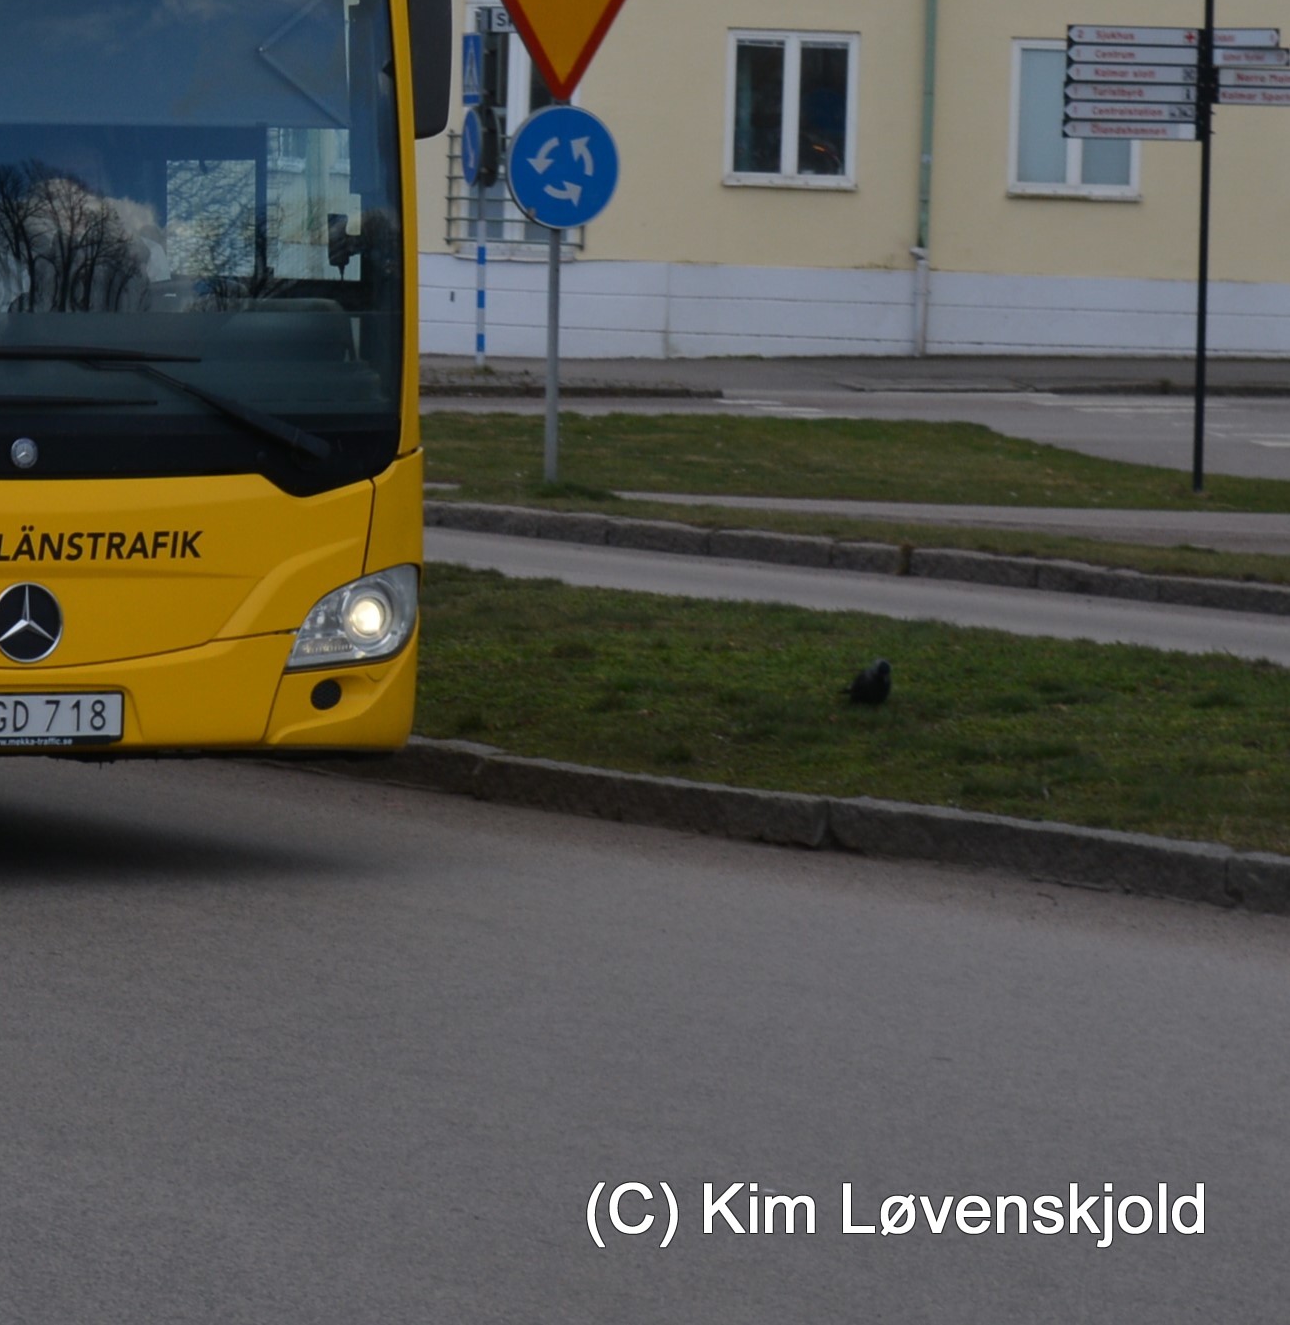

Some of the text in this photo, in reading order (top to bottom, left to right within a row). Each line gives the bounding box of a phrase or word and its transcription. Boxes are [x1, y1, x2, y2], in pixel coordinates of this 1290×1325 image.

[1095, 29, 1135, 41] Sjukhus
[1094, 49, 1136, 59] Centrum
[1093, 66, 1129, 78] Kalmar
[44, 699, 107, 732] 718
